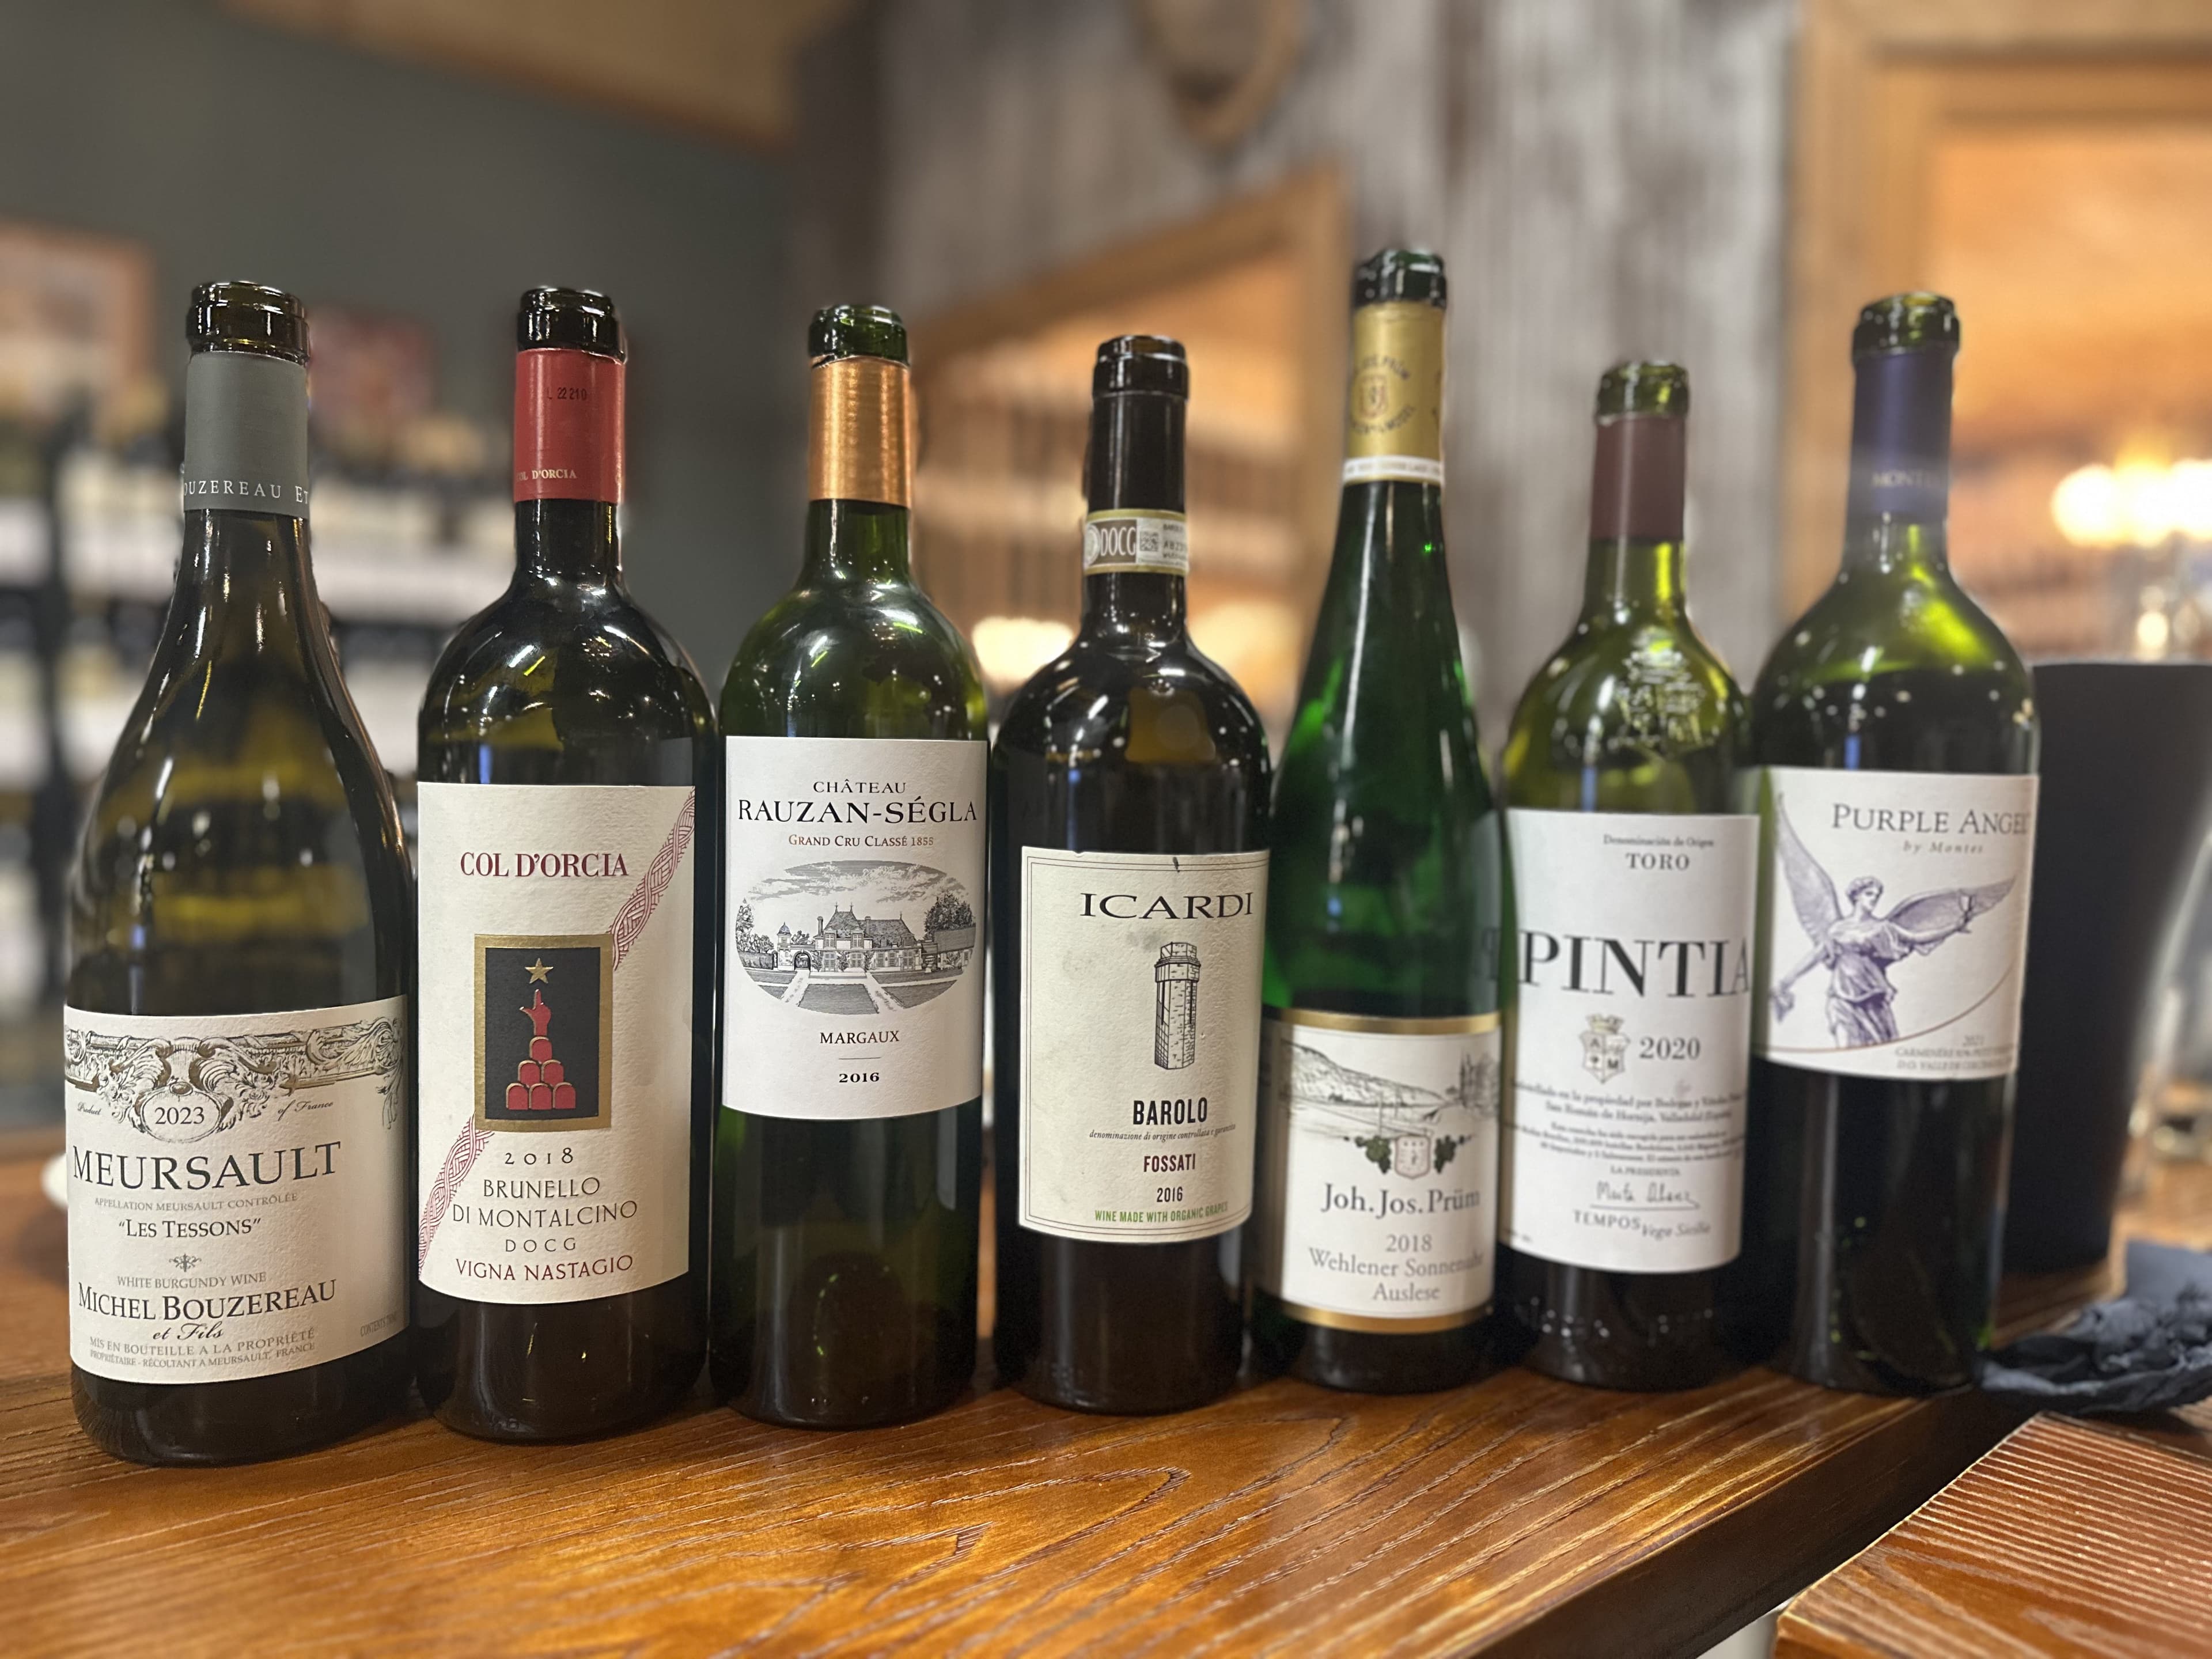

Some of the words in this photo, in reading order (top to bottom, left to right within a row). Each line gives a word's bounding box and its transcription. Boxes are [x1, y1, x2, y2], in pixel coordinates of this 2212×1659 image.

[532, 469, 577, 479] D'ORCIA
[184, 480, 281, 498] OUZEREAU
[1101, 527, 1136, 556] DOCG
[813, 779, 907, 794] CHÂTEAU
[738, 796, 978, 824] RAUZAN-SÉGLA
[1832, 803, 1949, 834] PURPLE
[788, 834, 830, 846] GRAND
[835, 835, 861, 847] CRU
[865, 835, 908, 847] CLASSÉ
[911, 836, 934, 846] 1855
[461, 852, 509, 877] COL
[514, 853, 629, 877] D'ORCIA
[1626, 853, 1690, 871] TORO
[1080, 892, 1254, 919] ICARDI
[1520, 929, 1750, 998] PINTIA
[820, 1030, 900, 1044] MARGAUX
[1639, 1037, 1701, 1060] 2020
[839, 1072, 880, 1083] 2016
[155, 1107, 205, 1125] 2023
[278, 1099, 293, 1122] of
[294, 1101, 334, 1113] France
[1132, 1097, 1208, 1125] BAROLO
[1089, 1130, 1142, 1140] denominazione
[1143, 1131, 1150, 1140] di
[1152, 1131, 1176, 1143] origine
[1177, 1126, 1210, 1140] controllata
[73, 1141, 342, 1190] MEURSAULT
[505, 1147, 574, 1165] 2018
[1143, 1153, 1196, 1172] FOSSATI
[483, 1177, 600, 1198] BRUNELLO
[1156, 1186, 1183, 1203] 2016
[94, 1197, 153, 1211] APPELLATION
[156, 1202, 224, 1211] MEURSAULT
[228, 1192, 299, 1209] CONTRÔLÉE
[453, 1204, 469, 1224] DI
[479, 1200, 638, 1228] MONTALCINO
[1095, 1210, 1116, 1222] WINE
[1120, 1211, 1143, 1222] MADE
[1146, 1211, 1168, 1222] WITH
[1171, 1207, 1203, 1221] ORGANIC
[1573, 1210, 1641, 1231] TEMPOS
[505, 1237, 576, 1252] DOCG
[1385, 1234, 1433, 1253] 2018
[456, 1258, 516, 1281] VIGNA
[524, 1255, 633, 1281] NASTAGIO
[1309, 1247, 1399, 1278] Wehlener
[118, 1275, 151, 1288] WHITE
[155, 1276, 226, 1289] BURGUNDY
[231, 1271, 267, 1286] WINE
[79, 1282, 156, 1320] MICHEL
[162, 1279, 336, 1320] BOUZEREAU
[1373, 1282, 1440, 1302] Auslese
[153, 1327, 172, 1340] et
[177, 1320, 224, 1340] Fils
[90, 1336, 105, 1349] MIS
[108, 1340, 120, 1352] EN
[124, 1344, 194, 1355] BOUTEILLE
[199, 1345, 208, 1355] A
[214, 1344, 232, 1353] LA
[237, 1327, 315, 1351] PROPRIÉTÉ
[143, 1359, 196, 1368] RÉCOLTANT
[200, 1359, 206, 1368] A
[276, 1342, 315, 1358] FRANCE
